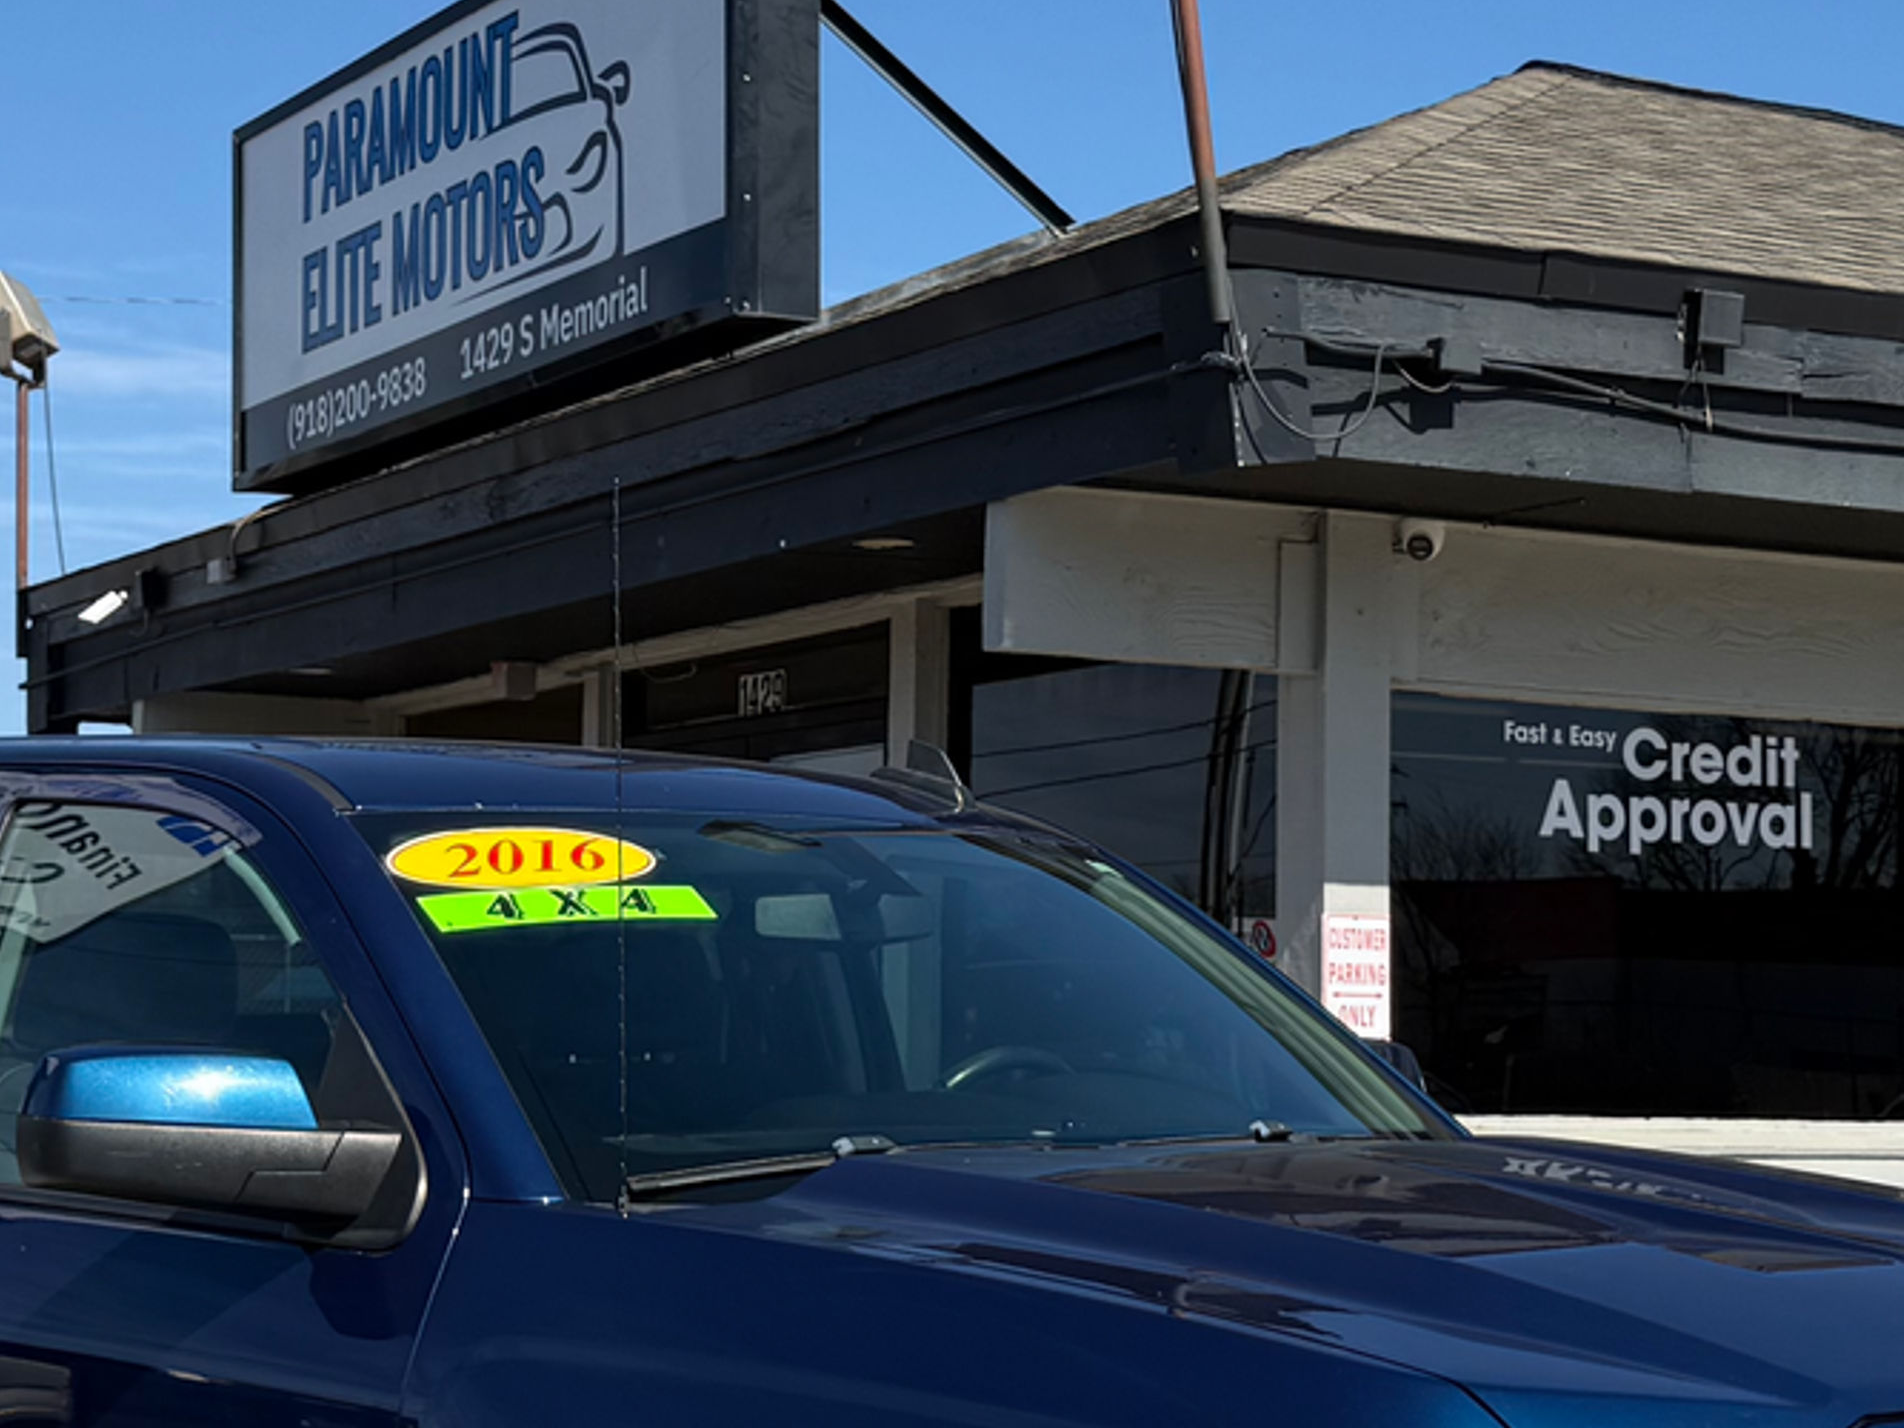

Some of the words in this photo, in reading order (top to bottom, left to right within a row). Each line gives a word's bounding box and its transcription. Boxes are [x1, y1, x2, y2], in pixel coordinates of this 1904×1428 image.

[302, 10, 520, 224] PARAMOUNT
[301, 221, 383, 356] ELITE
[391, 145, 546, 319] MOTORS
[286, 356, 427, 450] (918)200-9838
[460, 322, 514, 380] 1429
[519, 313, 534, 358] S
[540, 265, 648, 351] Memorial
[1503, 720, 1547, 744] Fast
[1552, 727, 1563, 745] &
[1569, 724, 1617, 753] Easy
[1622, 726, 1800, 788] Credit
[1538, 778, 1814, 855] Approval
[446, 837, 606, 878] 2016
[1328, 927, 1387, 951] CUSTOMER
[1328, 962, 1387, 986] PARKING
[1338, 1005, 1377, 1028] ONLY
